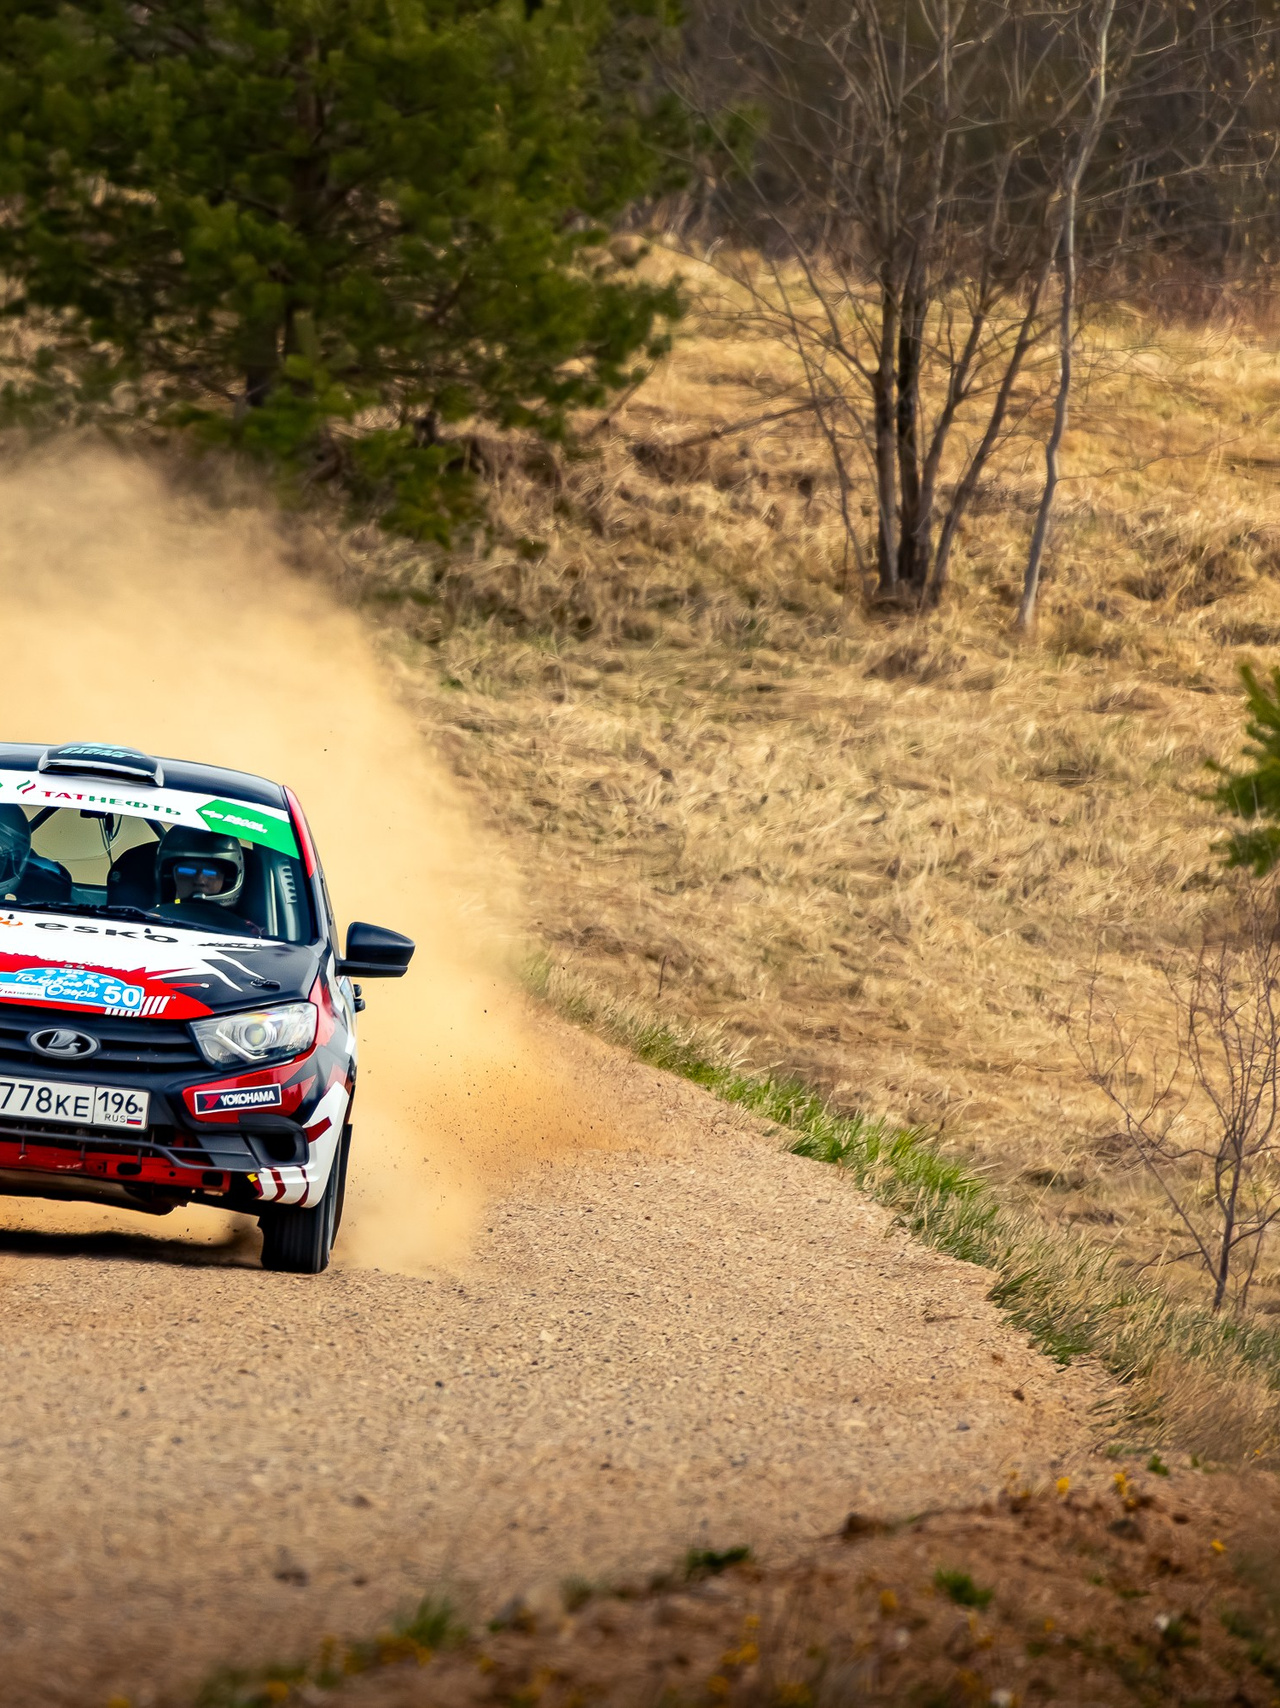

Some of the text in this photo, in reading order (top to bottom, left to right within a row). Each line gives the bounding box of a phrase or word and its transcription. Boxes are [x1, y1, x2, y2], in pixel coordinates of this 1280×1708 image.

[41, 790, 182, 816] ТАТНЕФТЬ
[34, 922, 179, 943] esko
[102, 985, 141, 1007] 50
[97, 1091, 139, 1114] 196
[220, 1090, 276, 1106] YOKOHAMA
[104, 1113, 126, 1123] RUS
